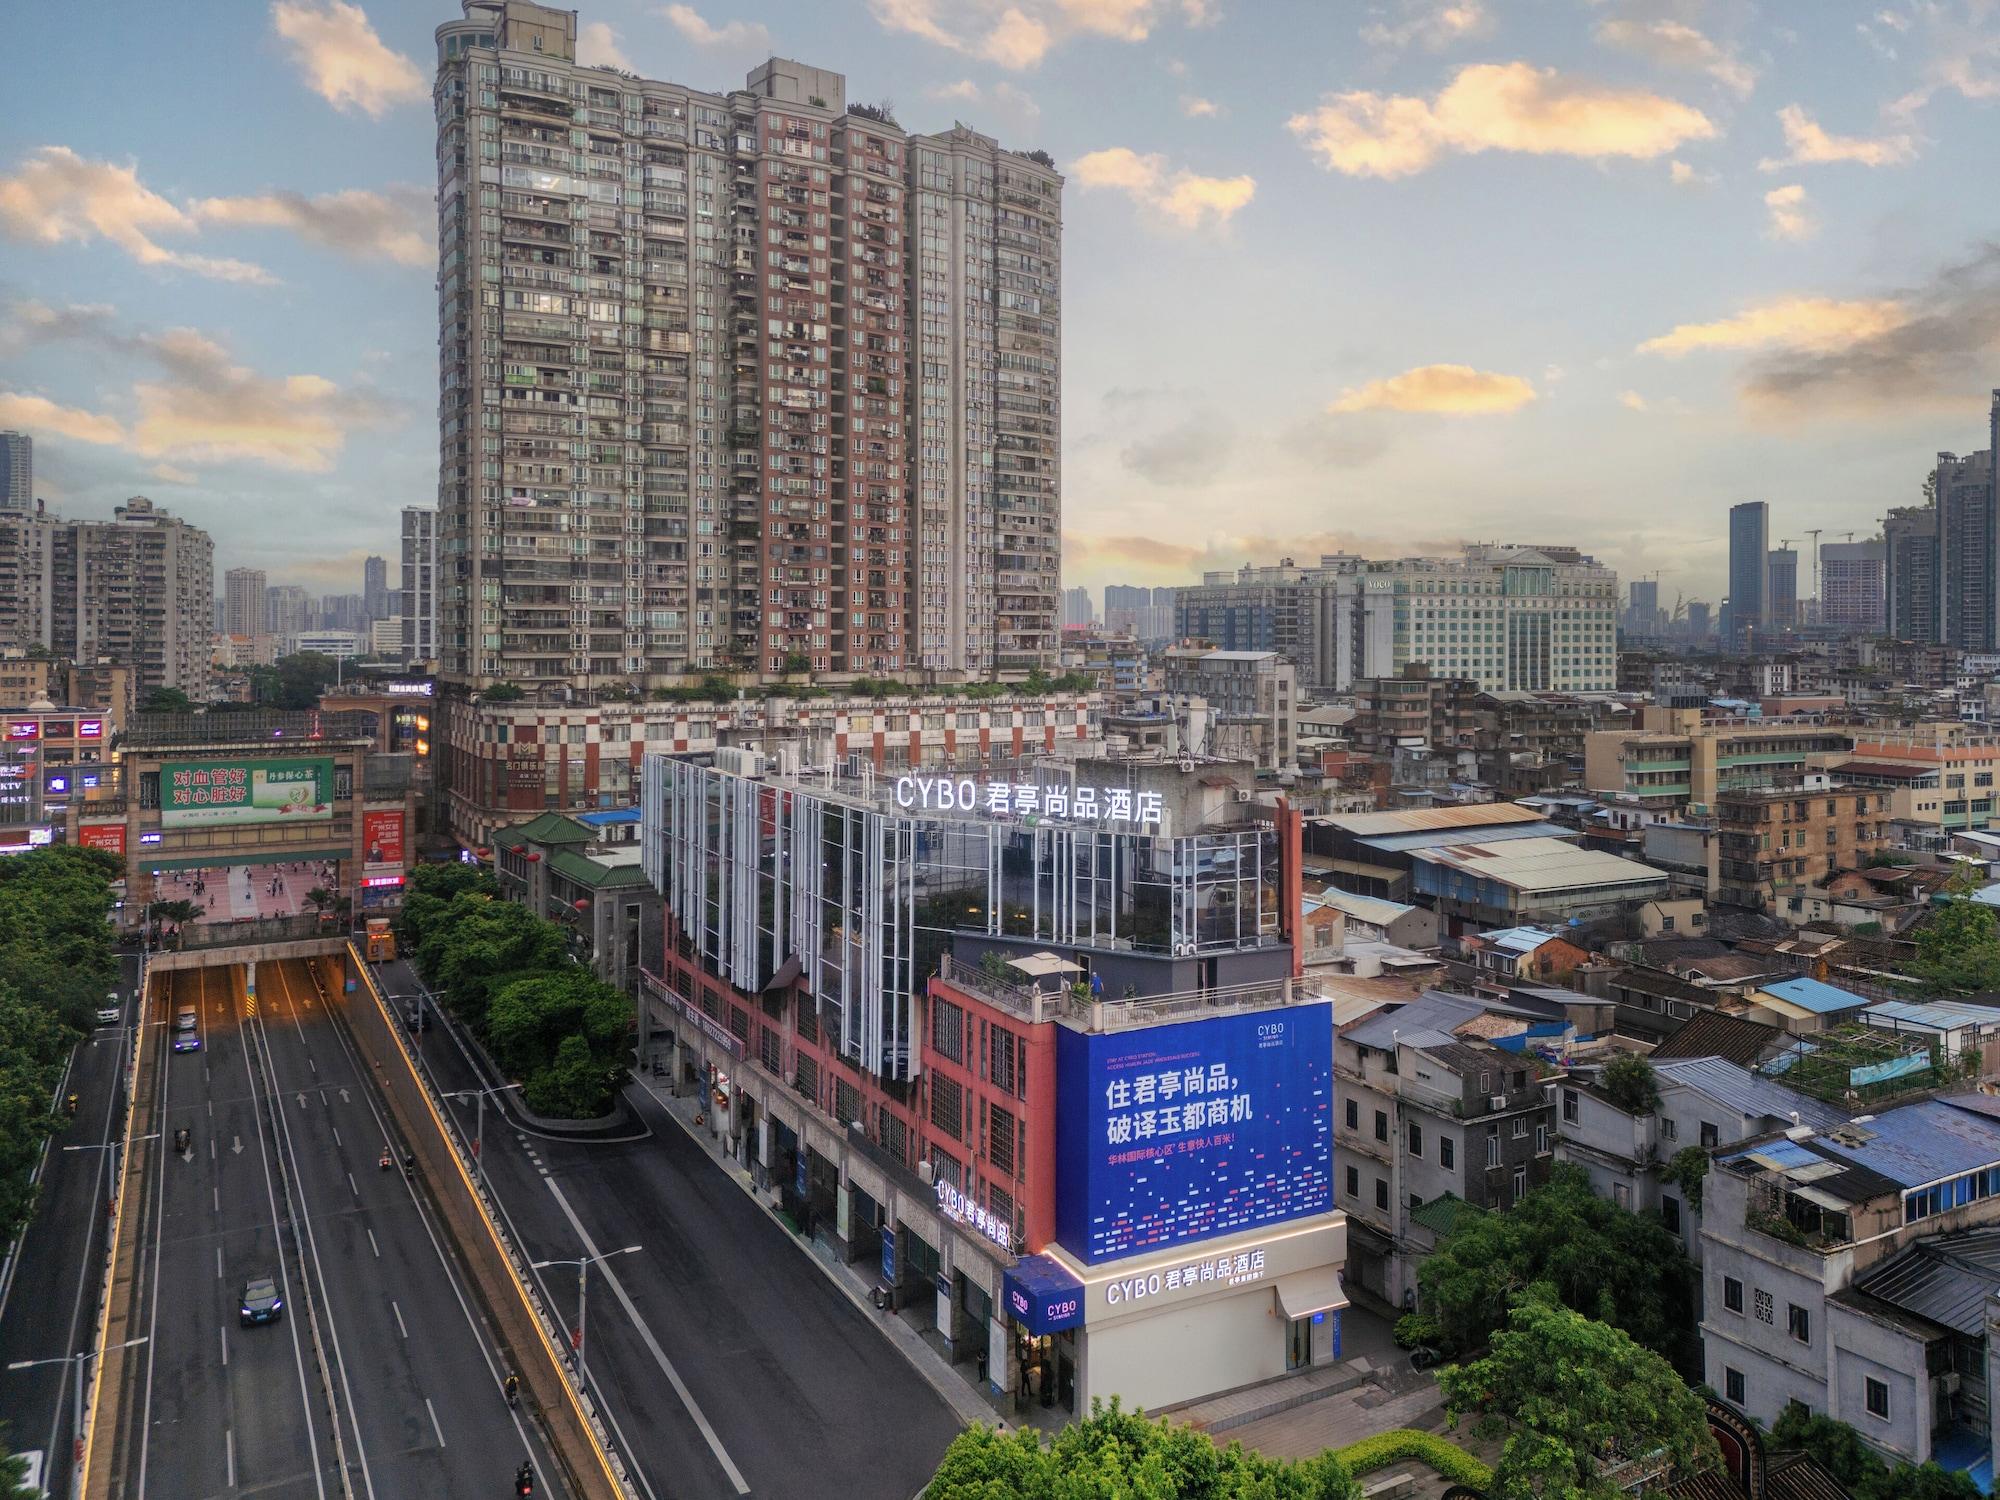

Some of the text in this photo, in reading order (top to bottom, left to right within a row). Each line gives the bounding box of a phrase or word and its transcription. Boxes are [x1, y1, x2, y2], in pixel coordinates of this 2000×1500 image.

[505, 761, 545, 771] 名门俱乐部
[0, 782, 22, 790] KTV
[173, 767, 246, 786] 对血管好
[173, 786, 246, 805] 对心脏好
[897, 776, 1163, 824] CYBO 君亭尚品酒店
[1257, 1023, 1284, 1036] CYBO
[1105, 1063, 1239, 1110] 住君亭尚品，
[1106, 1094, 1253, 1145] 破译玉都商机
[938, 1179, 1010, 1248] CYBO 君亭尚品
[1106, 1249, 1265, 1304] CYBO 君亭尚品酒店
[1012, 1290, 1028, 1311] CYBO
[1047, 1299, 1076, 1316] CYBO
